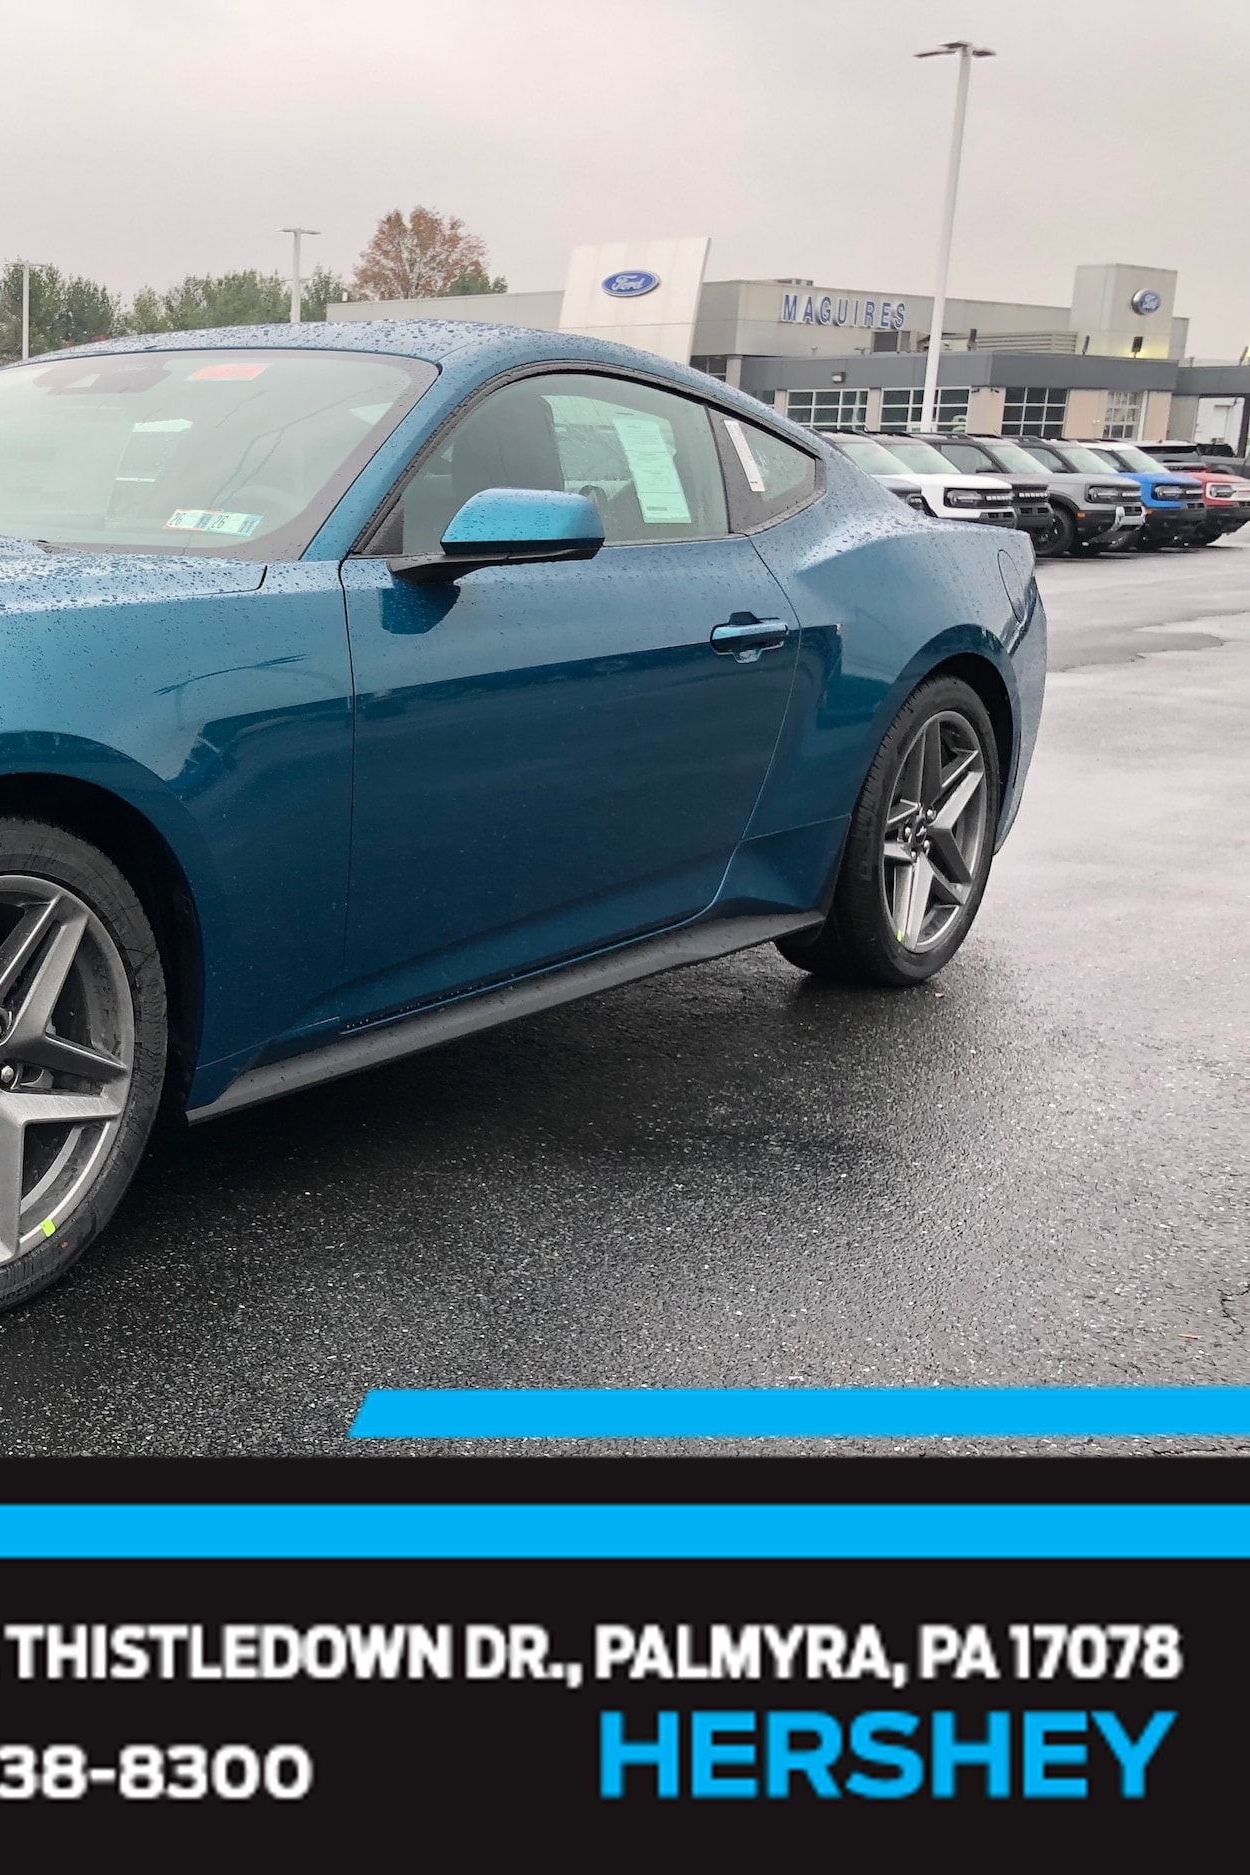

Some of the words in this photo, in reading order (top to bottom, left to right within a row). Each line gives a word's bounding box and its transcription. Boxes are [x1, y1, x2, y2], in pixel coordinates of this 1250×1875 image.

[782, 294, 906, 329] MAGUIRES
[170, 512, 186, 526] 26
[211, 514, 229, 529] 26
